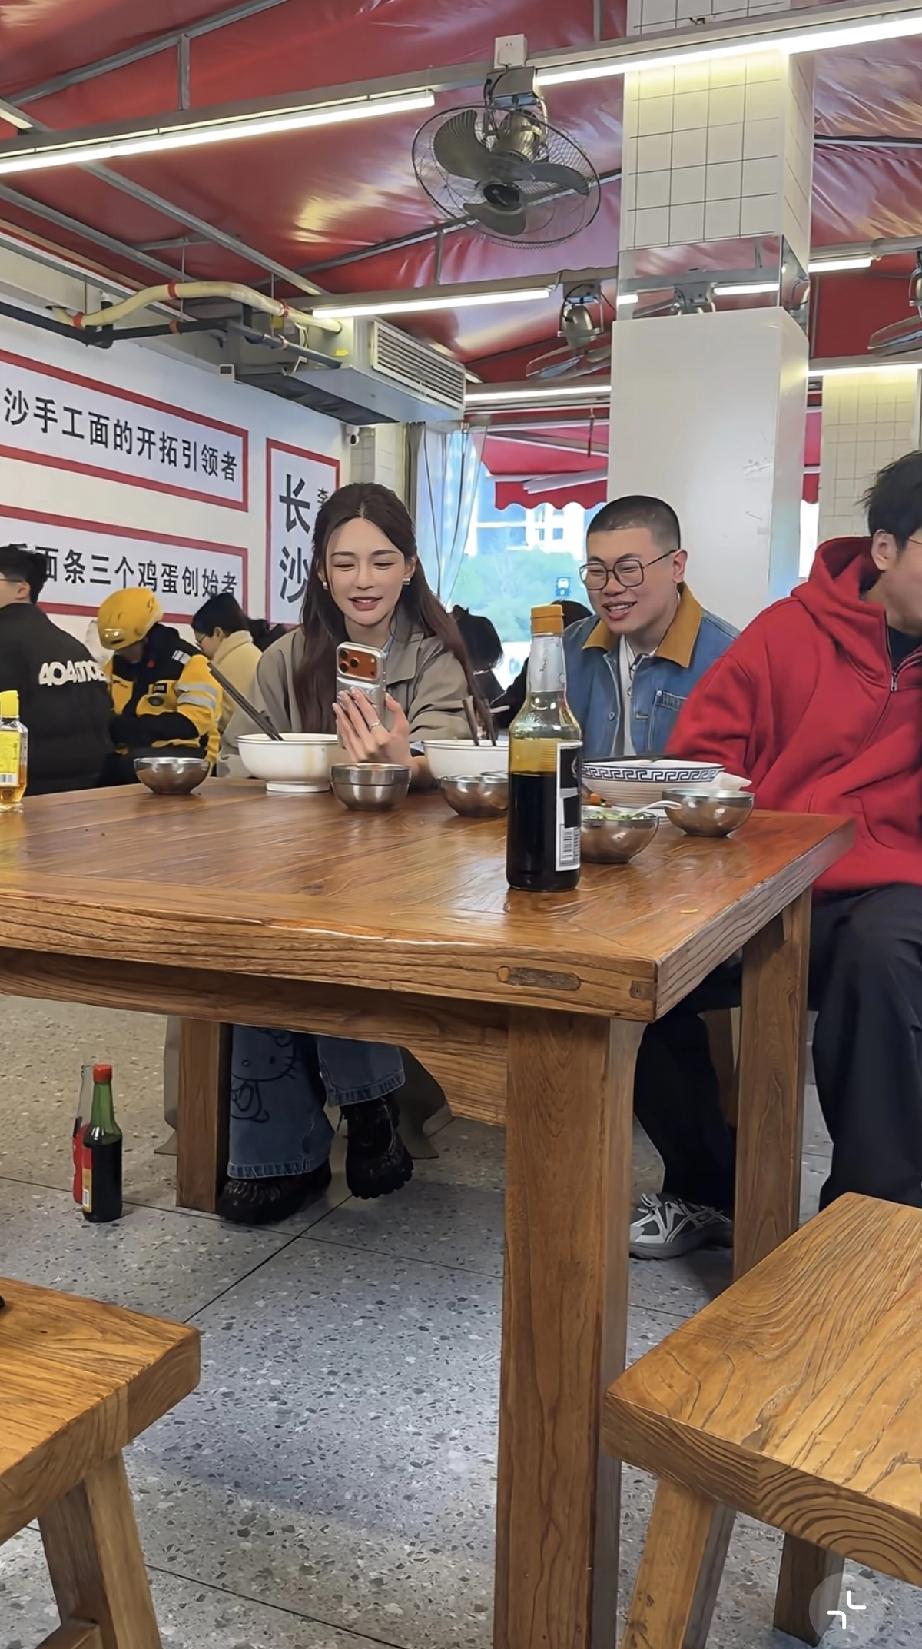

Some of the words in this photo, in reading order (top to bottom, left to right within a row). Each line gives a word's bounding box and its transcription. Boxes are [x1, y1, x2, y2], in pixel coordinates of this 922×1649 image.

[4, 387, 238, 482] 沙手工面的开拓引领者
[8, 544, 238, 598] 面条三个鸡蛋创始者
[279, 473, 311, 603] 长沙
